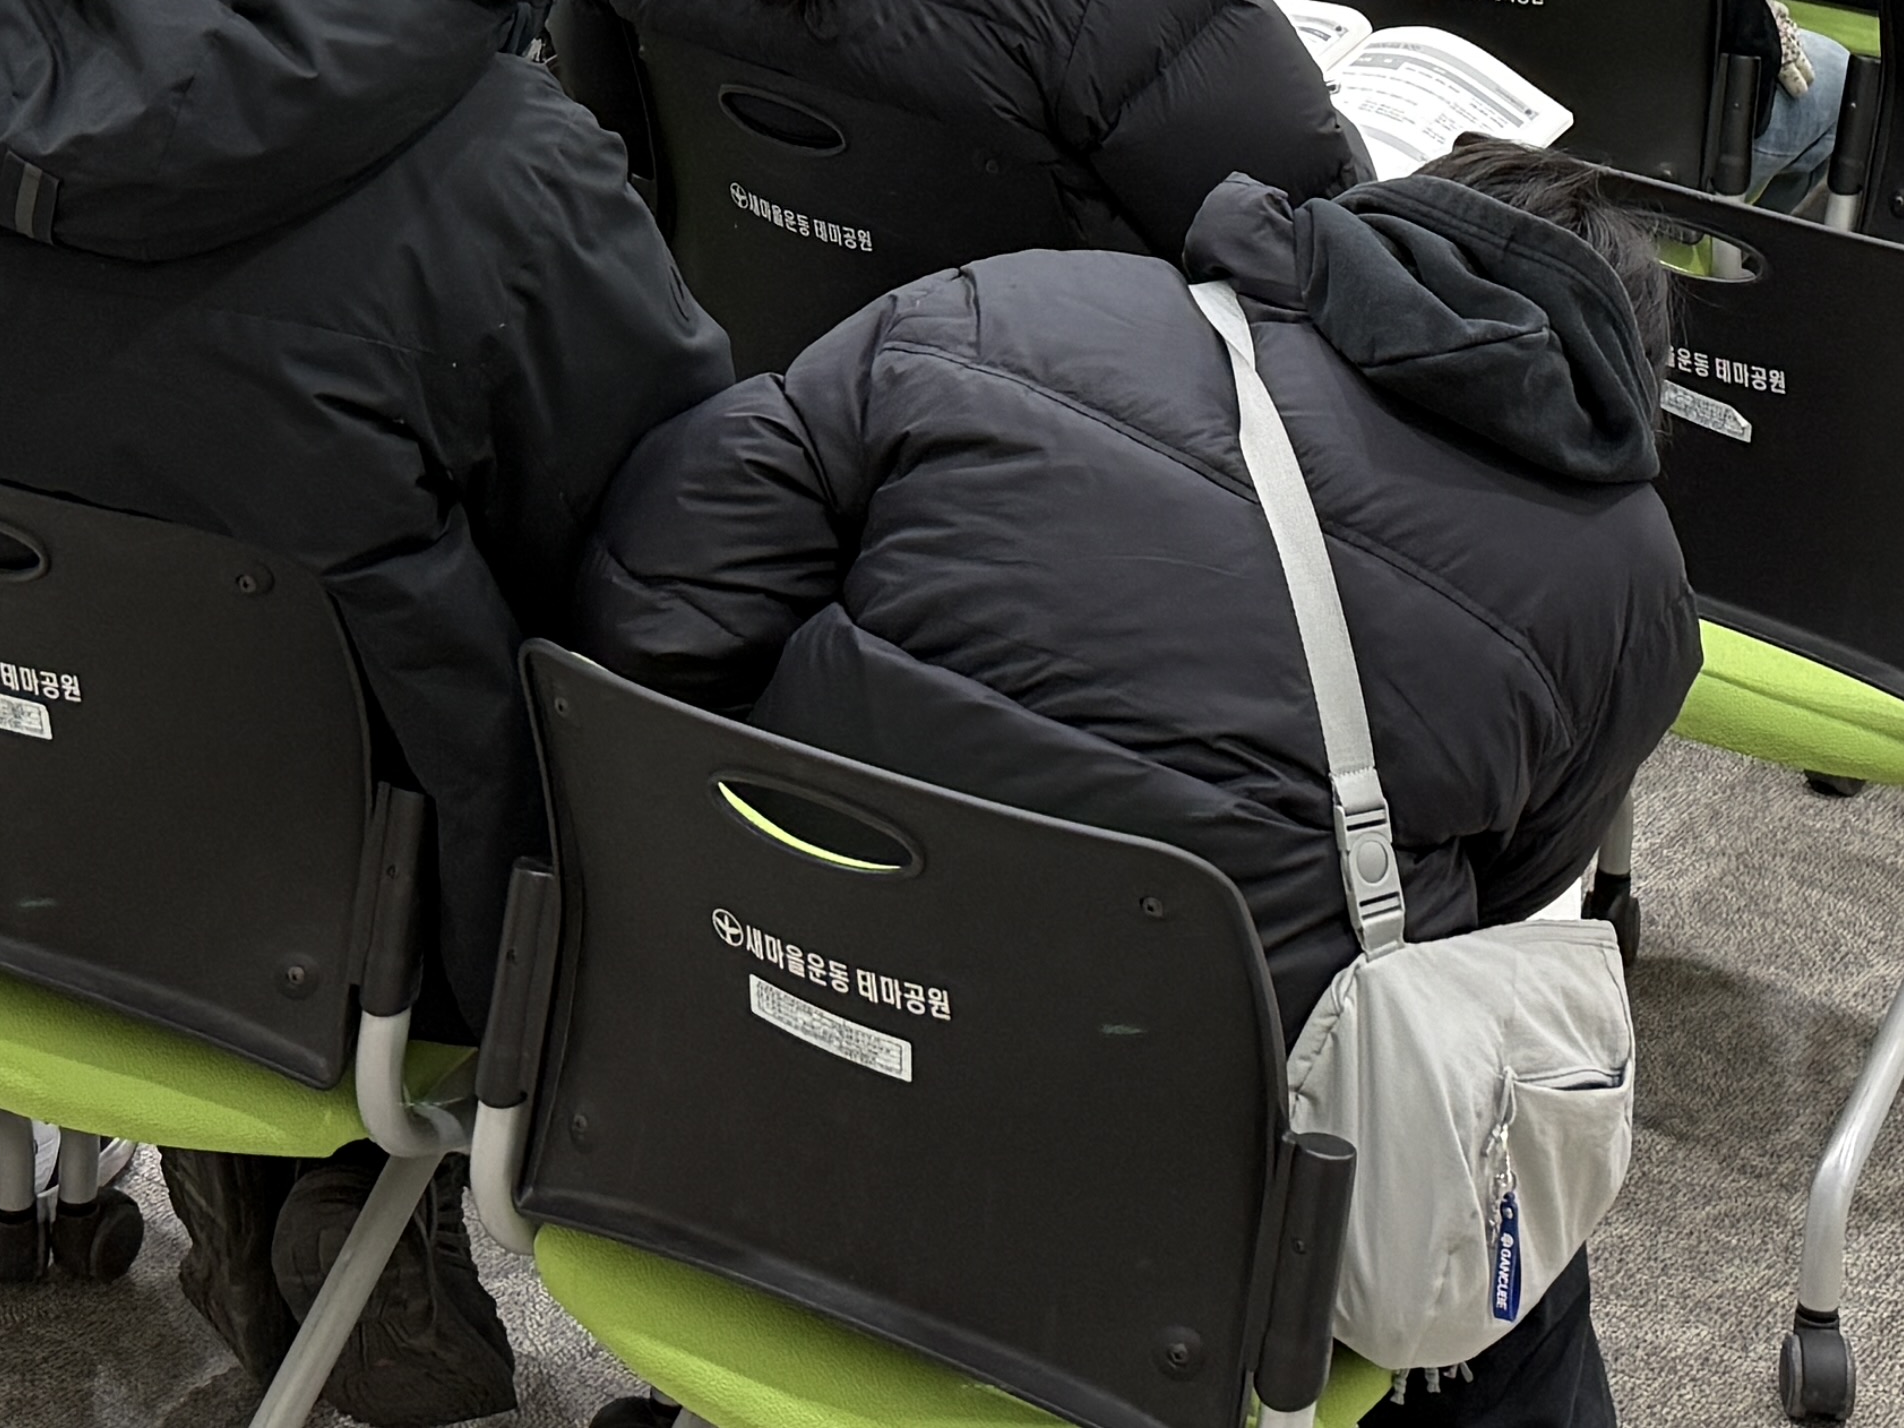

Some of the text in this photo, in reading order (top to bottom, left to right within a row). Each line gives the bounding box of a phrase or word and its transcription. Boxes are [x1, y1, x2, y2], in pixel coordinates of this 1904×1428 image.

[1714, 356, 1787, 395] 테마공원
[0, 661, 83, 703] 테마공원
[745, 923, 953, 1022] 새마을운동 테마공원
